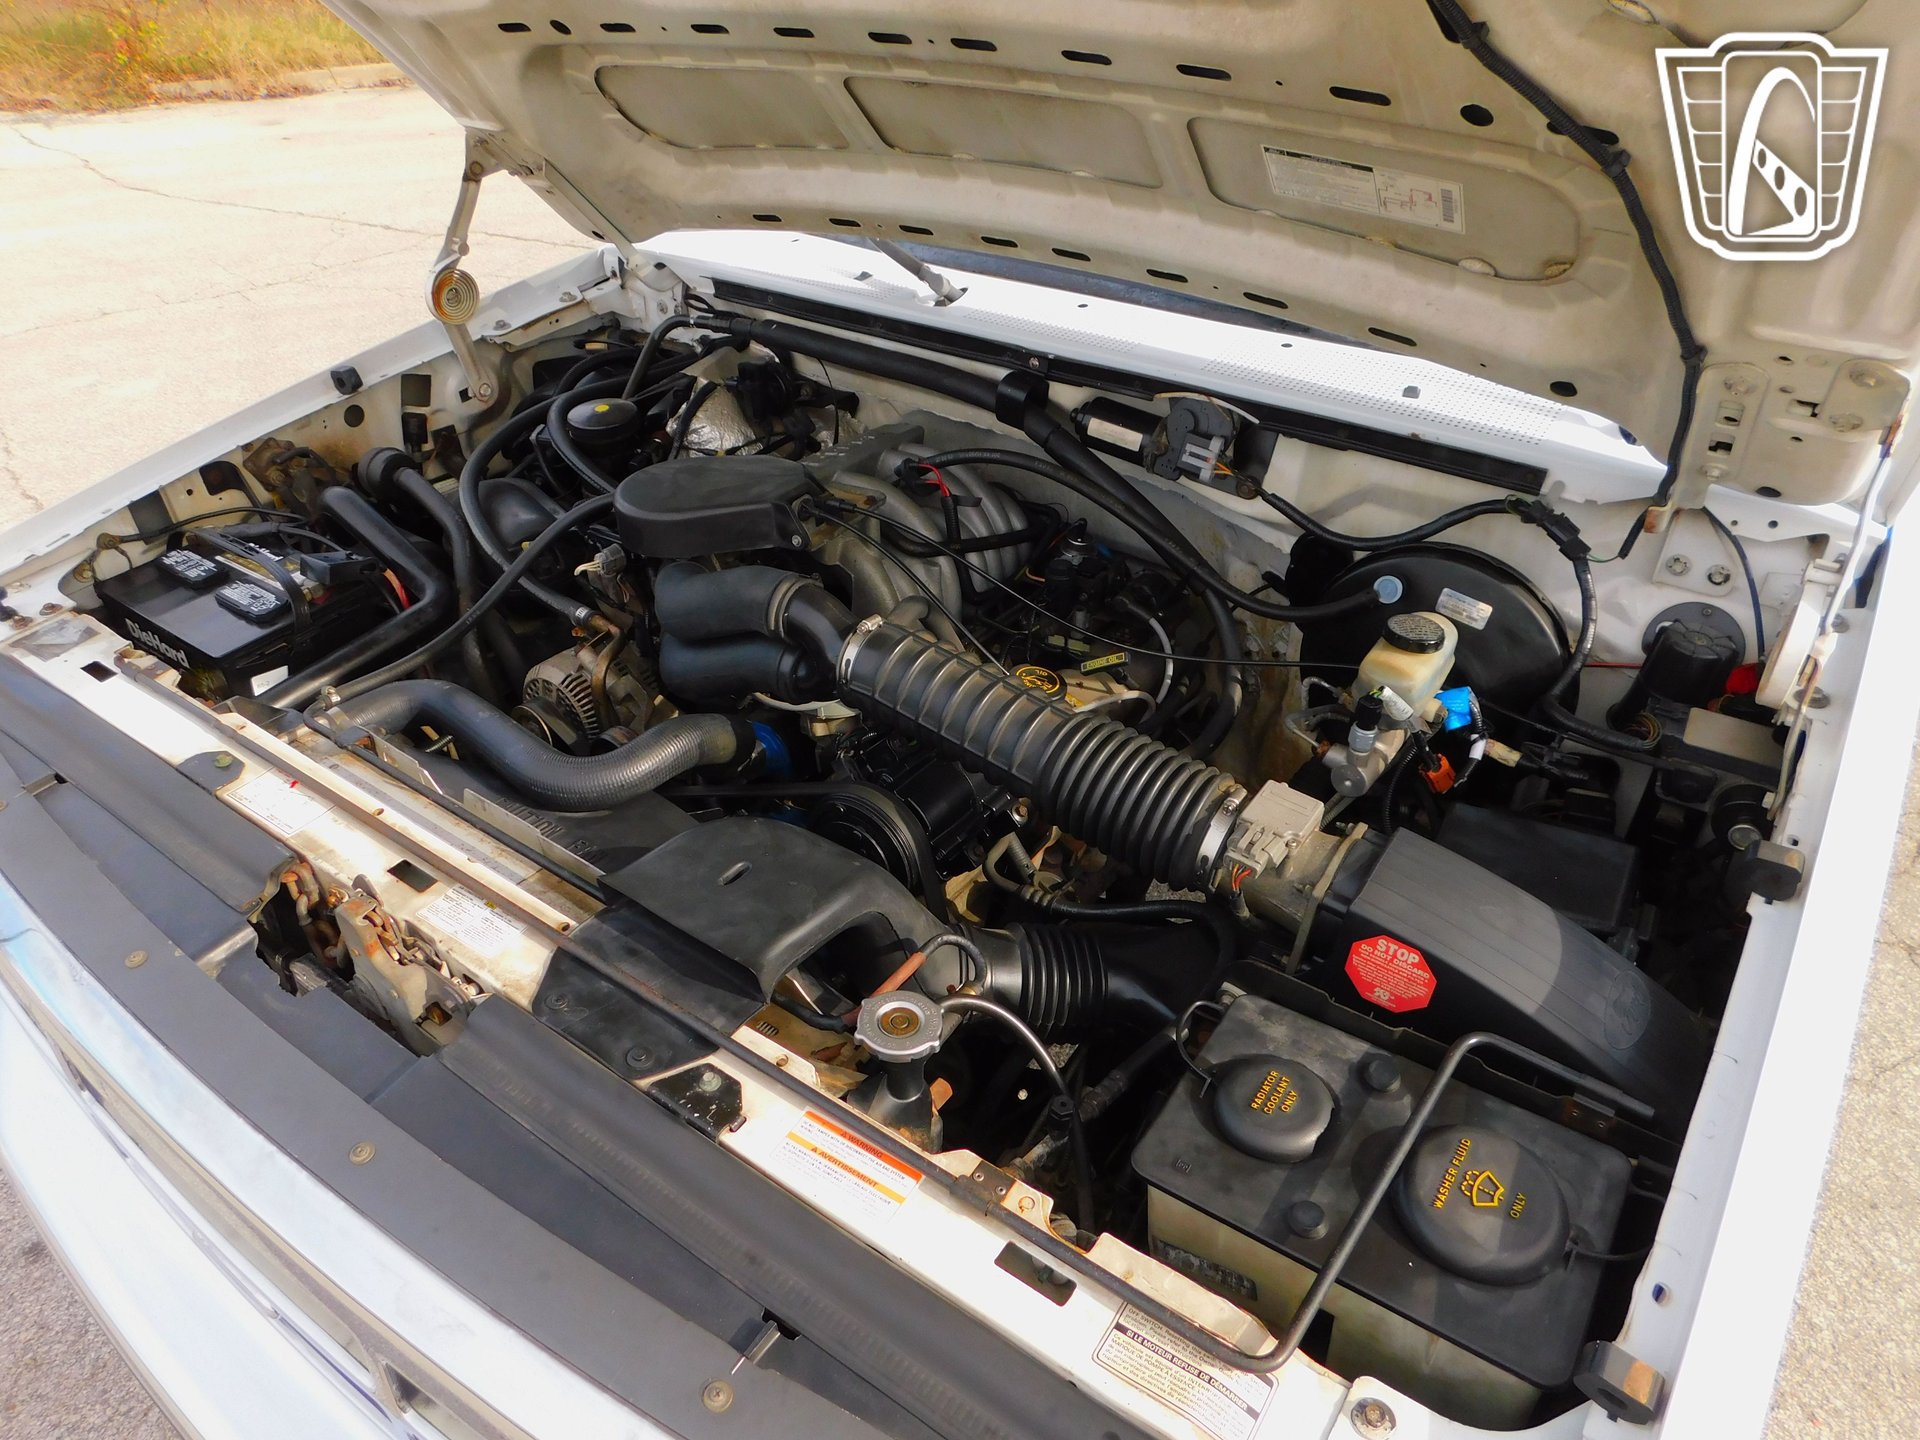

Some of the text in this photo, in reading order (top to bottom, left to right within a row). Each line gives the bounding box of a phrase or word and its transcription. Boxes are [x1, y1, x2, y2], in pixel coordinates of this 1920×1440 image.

[124, 618, 190, 668] DieHard
[1034, 669, 1048, 677] OIL
[1360, 943, 1430, 979] DO NOT DISCARD
[1374, 937, 1420, 967] STOP
[1250, 1069, 1279, 1110] RADIATOR
[1262, 1075, 1291, 1115] COOLANT
[1280, 1089, 1298, 1113] ONLY
[846, 1134, 884, 1158] WARNING
[818, 1149, 878, 1188] AVERTISSEMENT
[1432, 1138, 1471, 1209] WASHER FLUID
[1507, 1191, 1529, 1219] ONLY
[1127, 1307, 1139, 1317] OFF
[1148, 1326, 1167, 1339] Please
[1166, 1337, 1181, 1347] refer
[1188, 1349, 1198, 1358] the
[1125, 1329, 1134, 1338] SI
[1133, 1334, 1143, 1343] LE
[1142, 1339, 1173, 1360] MOTEUR
[1171, 1356, 1200, 1376] REFUSE
[1198, 1371, 1210, 1381] DE
[1209, 1378, 1248, 1410] DÉMARRER
[1134, 1352, 1144, 1361] DE
[1142, 1357, 1165, 1373] POMPE
